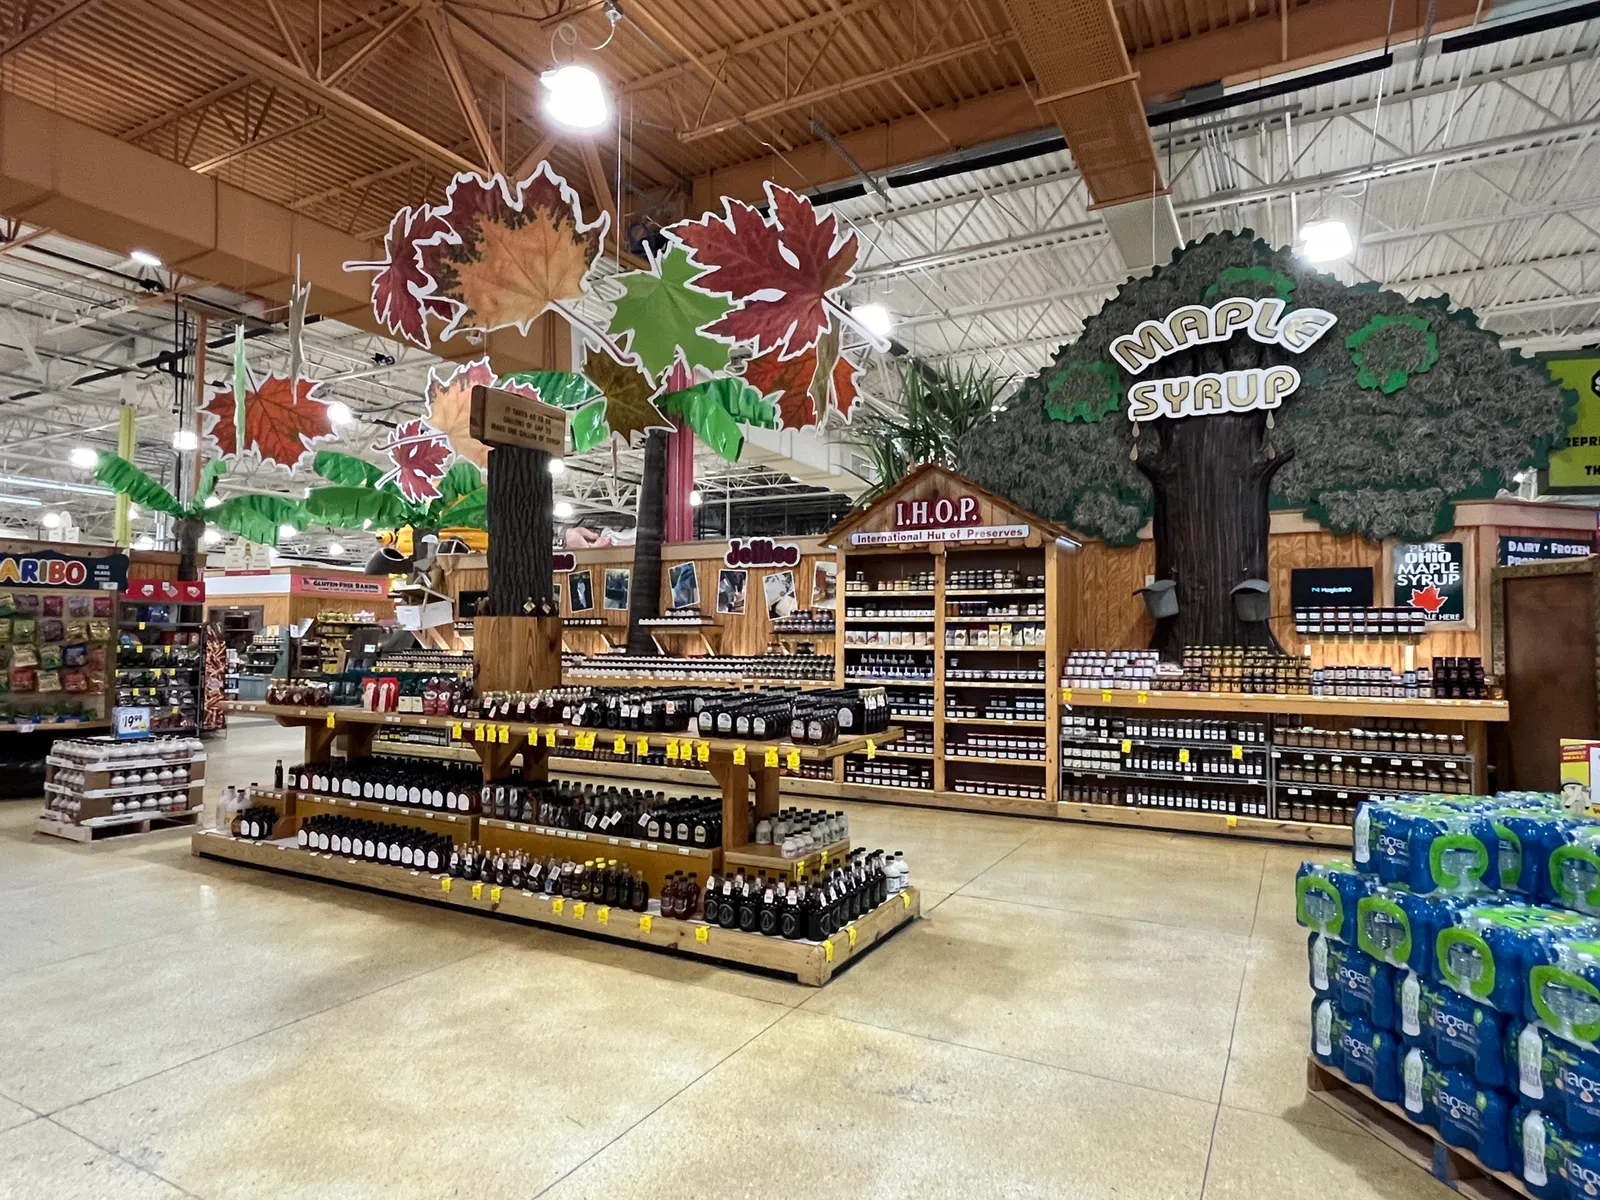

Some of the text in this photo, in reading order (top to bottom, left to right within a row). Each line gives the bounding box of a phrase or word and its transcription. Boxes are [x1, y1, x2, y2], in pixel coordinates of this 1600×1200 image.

[1113, 300, 1332, 372] MAPLE
[1131, 369, 1296, 418] SYRUP
[1566, 436, 1600, 448] EPR
[896, 497, 978, 526] I.H.O.P.
[857, 528, 1023, 543] International Hut of Preserves
[726, 539, 798, 566] Jellies
[1409, 543, 1445, 553] PURE
[1550, 542, 1590, 555] FROZEN
[1404, 551, 1452, 564] OHIO
[1397, 562, 1460, 575] MAPLE
[1397, 573, 1460, 586] SYRUP
